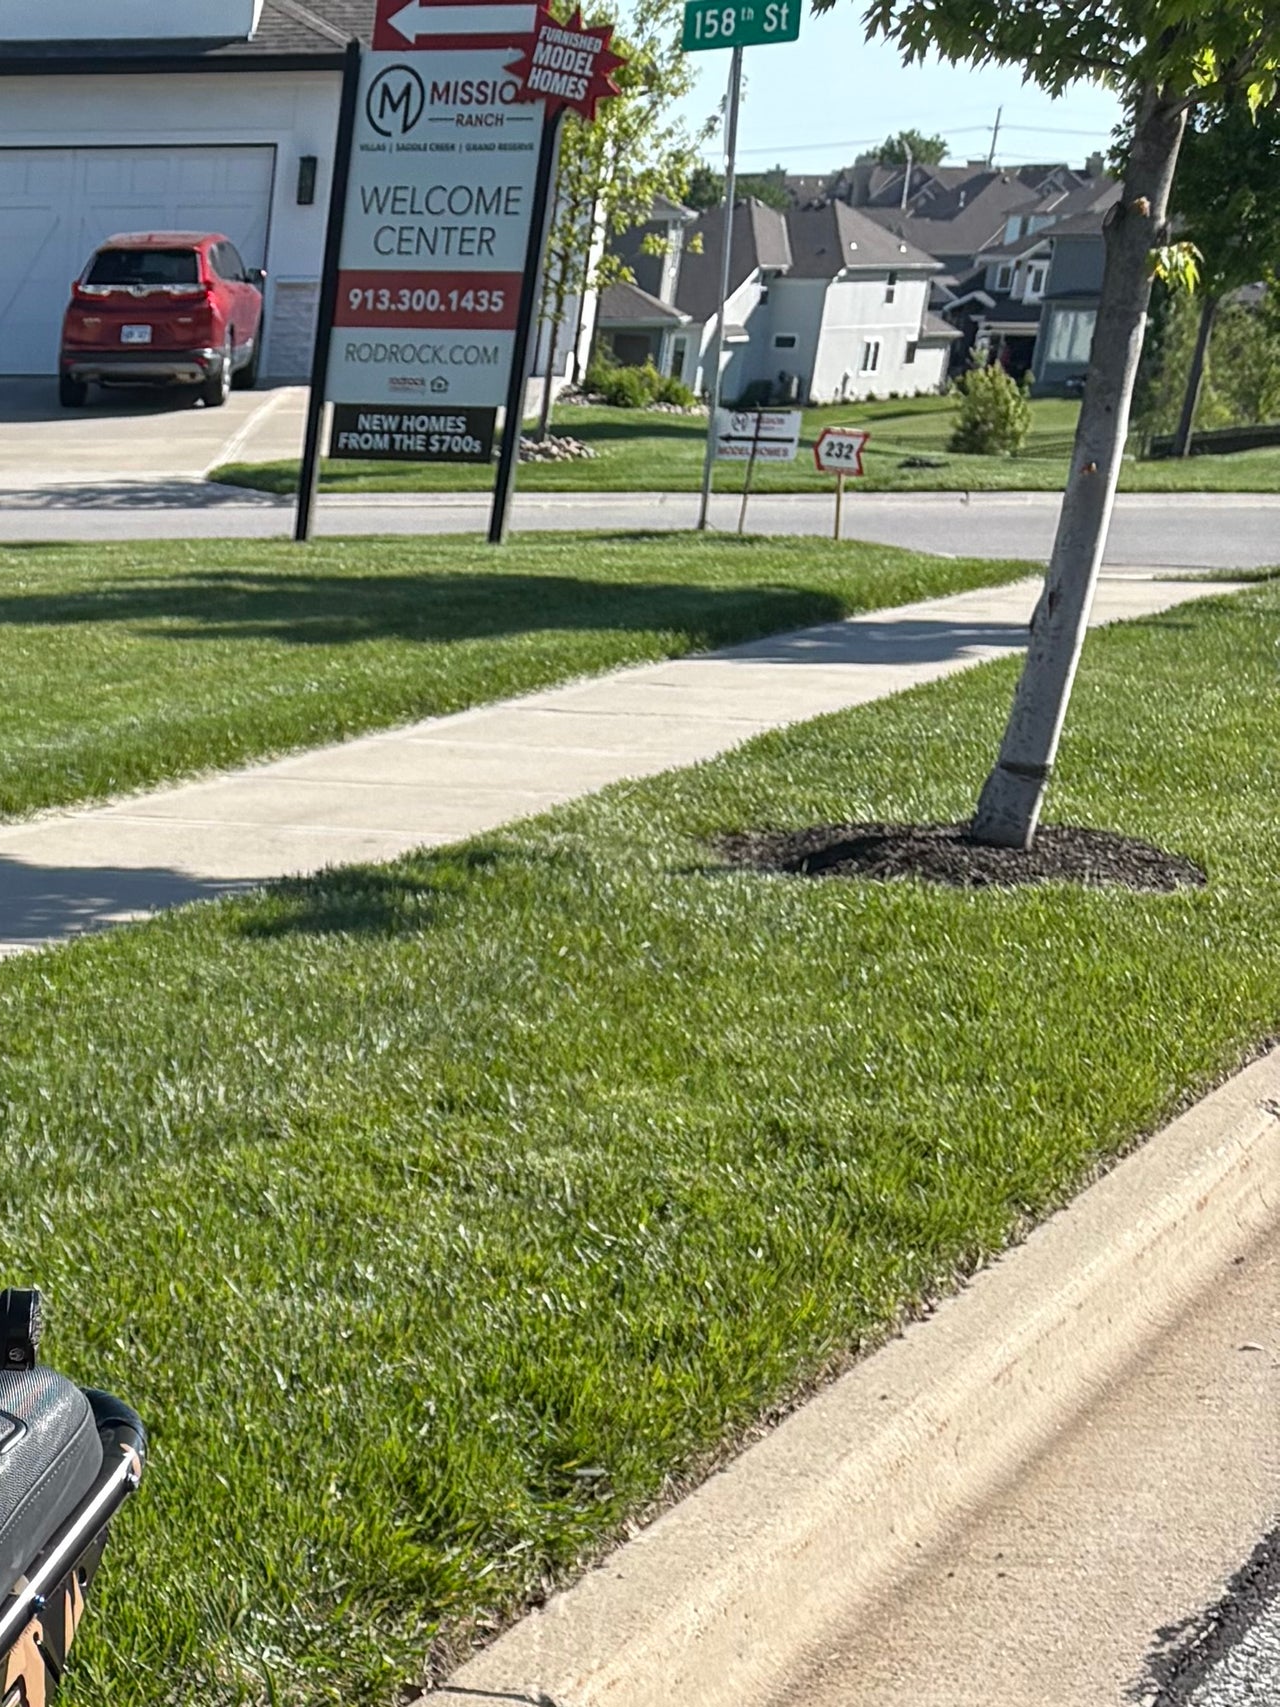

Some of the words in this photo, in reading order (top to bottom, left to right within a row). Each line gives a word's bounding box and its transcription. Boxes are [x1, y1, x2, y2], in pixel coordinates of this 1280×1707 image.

[763, 2, 789, 32] St
[538, 25, 603, 54] FURNISHED
[532, 41, 594, 77] MODEL
[429, 80, 536, 106] MISSIO
[527, 66, 589, 100] HOMES
[455, 113, 504, 127] RANCH
[360, 185, 524, 216] WELCOME
[373, 225, 497, 256] CENTER
[348, 288, 505, 313] 913.300.1435
[344, 342, 500, 366] RODROCK.COM
[357, 413, 400, 431] NEW
[401, 414, 467, 434] HOMES
[338, 432, 390, 450] FROM
[392, 433, 427, 452] THE
[428, 434, 483, 454] $700s
[825, 441, 854, 460] 232
